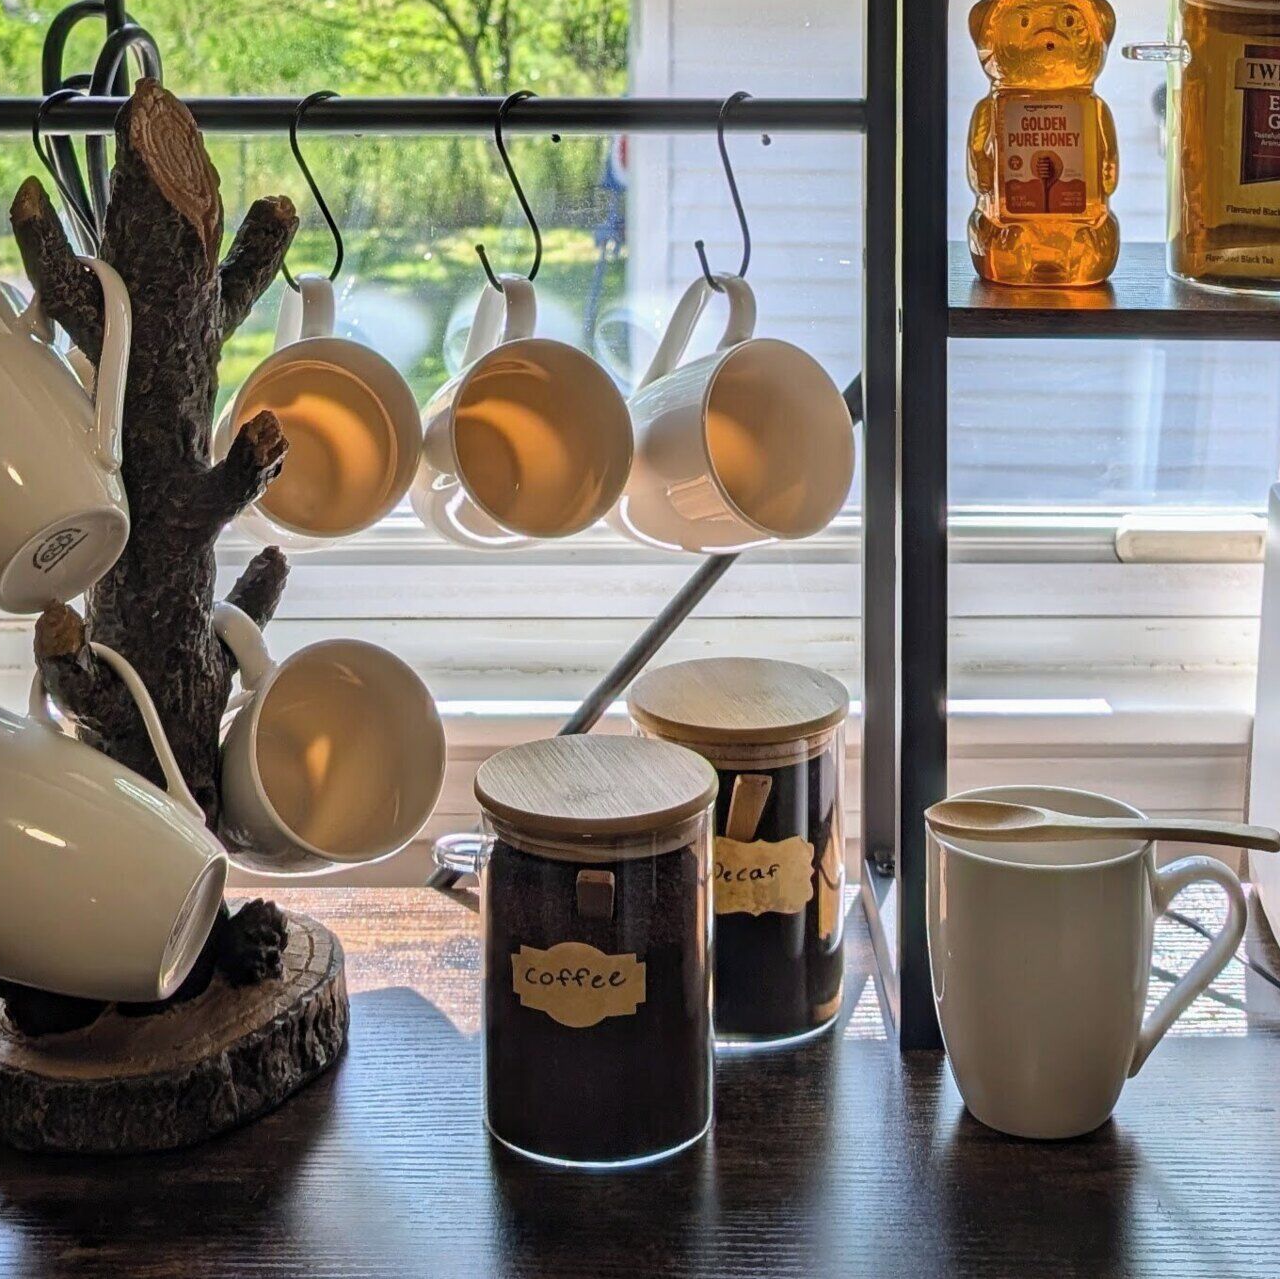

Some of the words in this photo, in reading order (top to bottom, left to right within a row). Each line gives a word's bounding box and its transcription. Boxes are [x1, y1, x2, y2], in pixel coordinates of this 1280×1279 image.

[1021, 116, 1067, 131] GOLDEN
[1008, 132, 1039, 147] PURE
[1041, 132, 1080, 147] HONEY
[1226, 204, 1261, 216] Flavoured
[1240, 255, 1260, 265] Black
[1262, 256, 1274, 265] Tea
[714, 862, 780, 882] Decaf
[525, 967, 627, 989] Coffee
